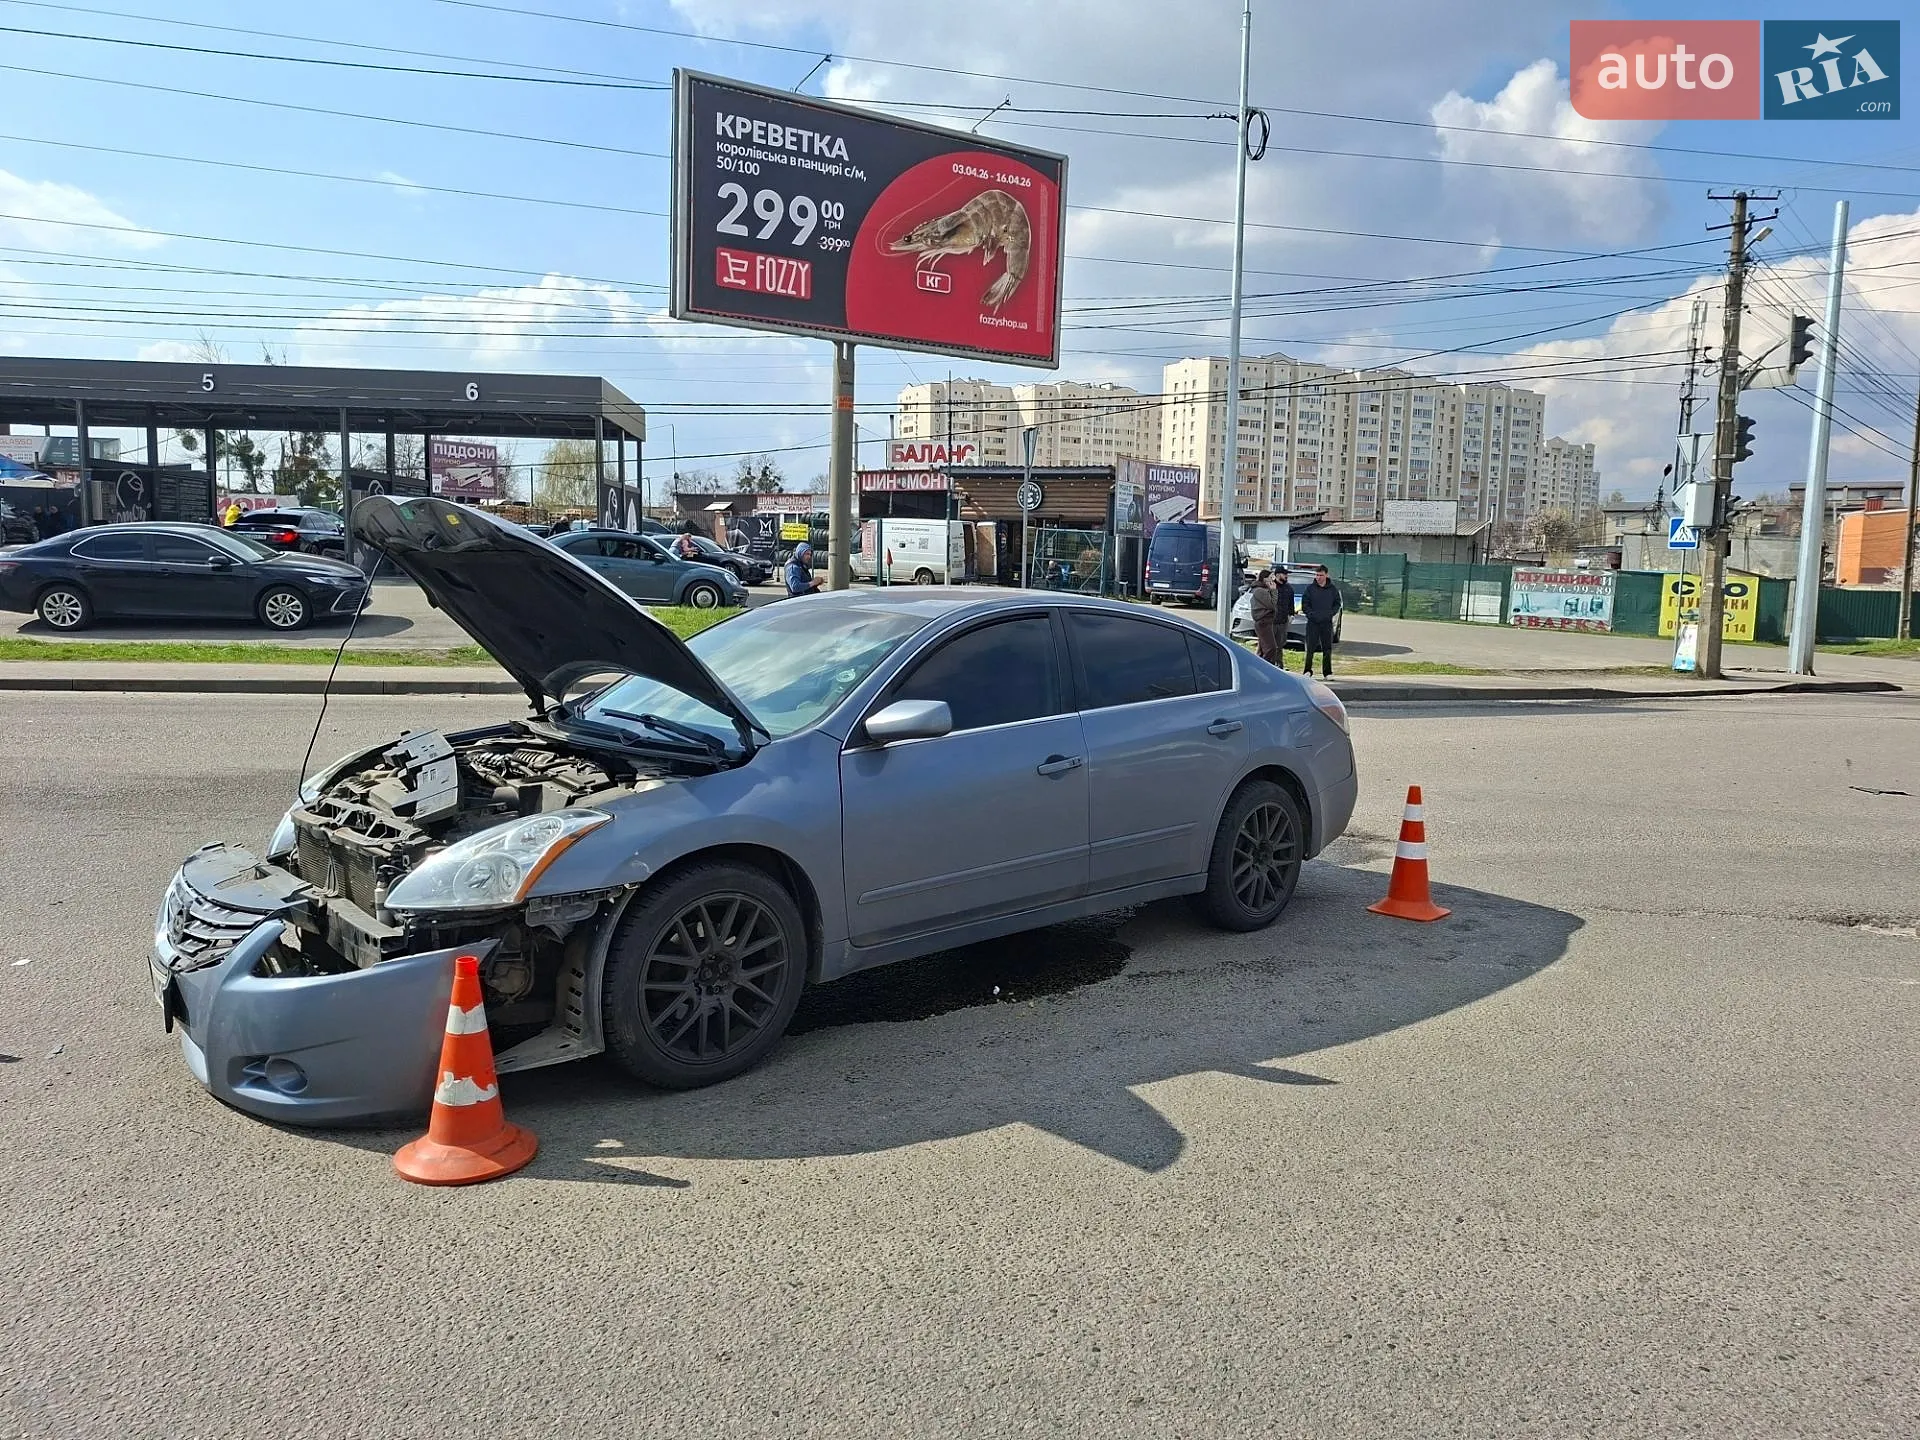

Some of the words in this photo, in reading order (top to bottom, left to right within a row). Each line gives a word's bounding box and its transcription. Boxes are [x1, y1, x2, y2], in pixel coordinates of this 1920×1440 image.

[716, 111, 850, 161] КРЕВЕТКА
[716, 141, 788, 164] королівська
[790, 157, 797, 166] в
[797, 158, 842, 176] панцирі
[844, 164, 867, 182] с/м,
[716, 155, 760, 176] 50/100
[952, 162, 989, 180] 03.04.26
[995, 172, 1032, 188] 16.04.26
[716, 182, 818, 246] 299
[821, 199, 845, 221] 00
[824, 219, 841, 231] грн
[756, 255, 809, 297] FOZZY
[979, 313, 1028, 330] fozzyshop.ua
[202, 373, 214, 392] 5
[465, 382, 479, 401] 6
[433, 443, 496, 460] ПІДДОНИ
[891, 443, 976, 464] БАЛАНС
[1149, 468, 1198, 484] ПІДДОНИ
[1513, 583, 1537, 592] 067
[1671, 580, 1749, 597] СО
[1512, 615, 1609, 632] ЗВАРКА
